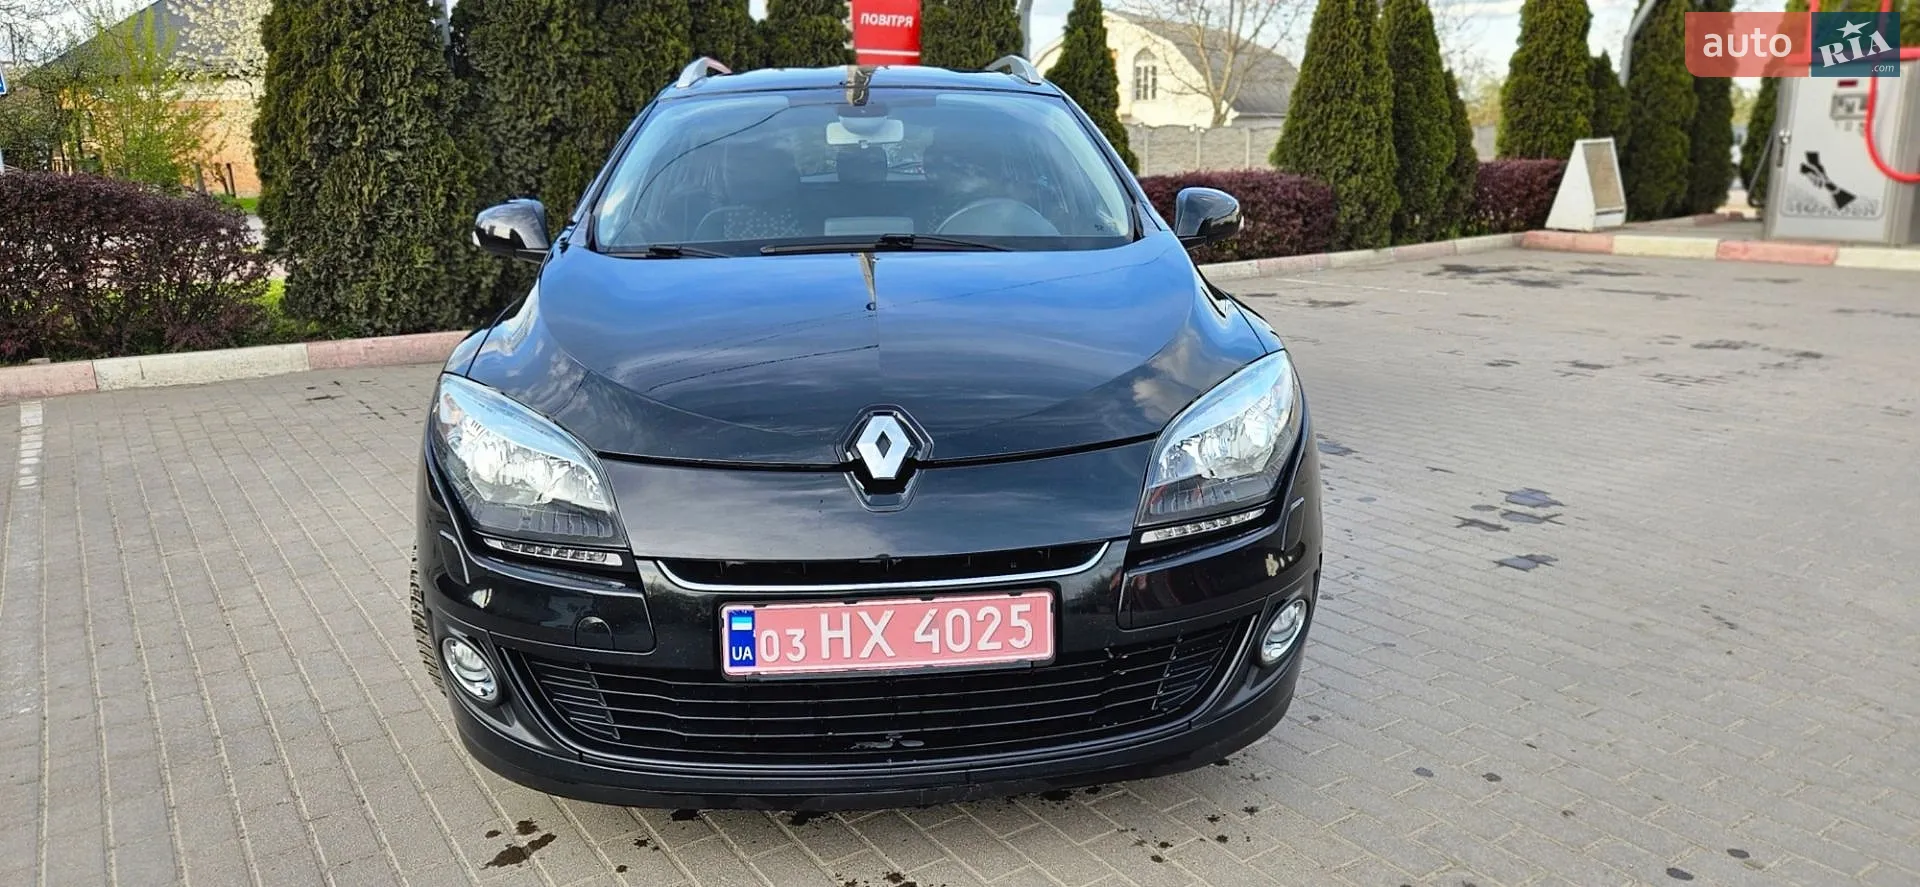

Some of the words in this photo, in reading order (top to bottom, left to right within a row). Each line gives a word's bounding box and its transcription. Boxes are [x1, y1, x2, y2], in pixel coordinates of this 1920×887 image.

[860, 12, 914, 28] ПОВІТРЯ
[759, 629, 807, 663] 03
[820, 609, 896, 660] HX
[914, 604, 1033, 654] 4025
[732, 647, 753, 661] UA
